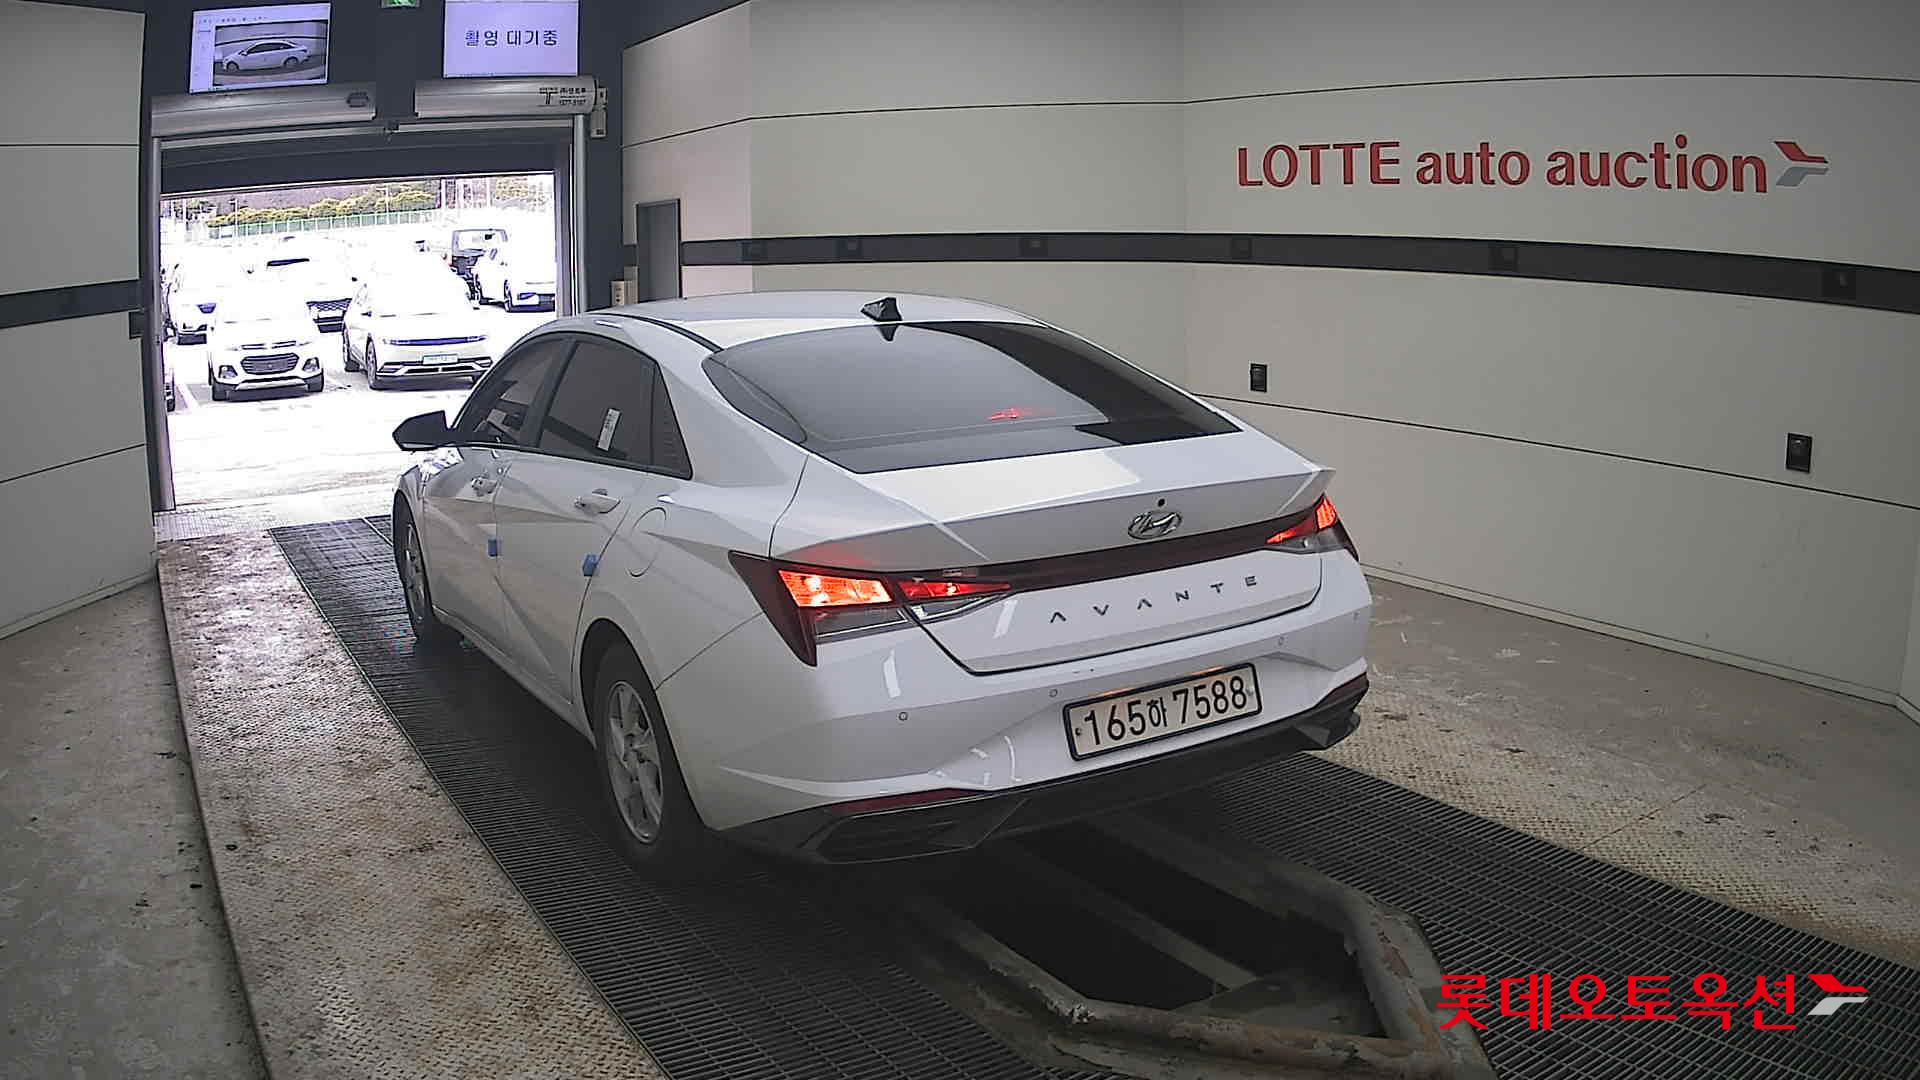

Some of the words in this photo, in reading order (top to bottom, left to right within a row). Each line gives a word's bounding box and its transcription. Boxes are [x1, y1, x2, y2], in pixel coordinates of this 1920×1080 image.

[507, 30, 557, 45] 대기중
[1238, 140, 1400, 187] LOTTE
[1415, 141, 1530, 186] auto
[1545, 134, 1768, 194] auction
[1050, 575, 1257, 623] AVANTE
[1172, 675, 1248, 725] 7588
